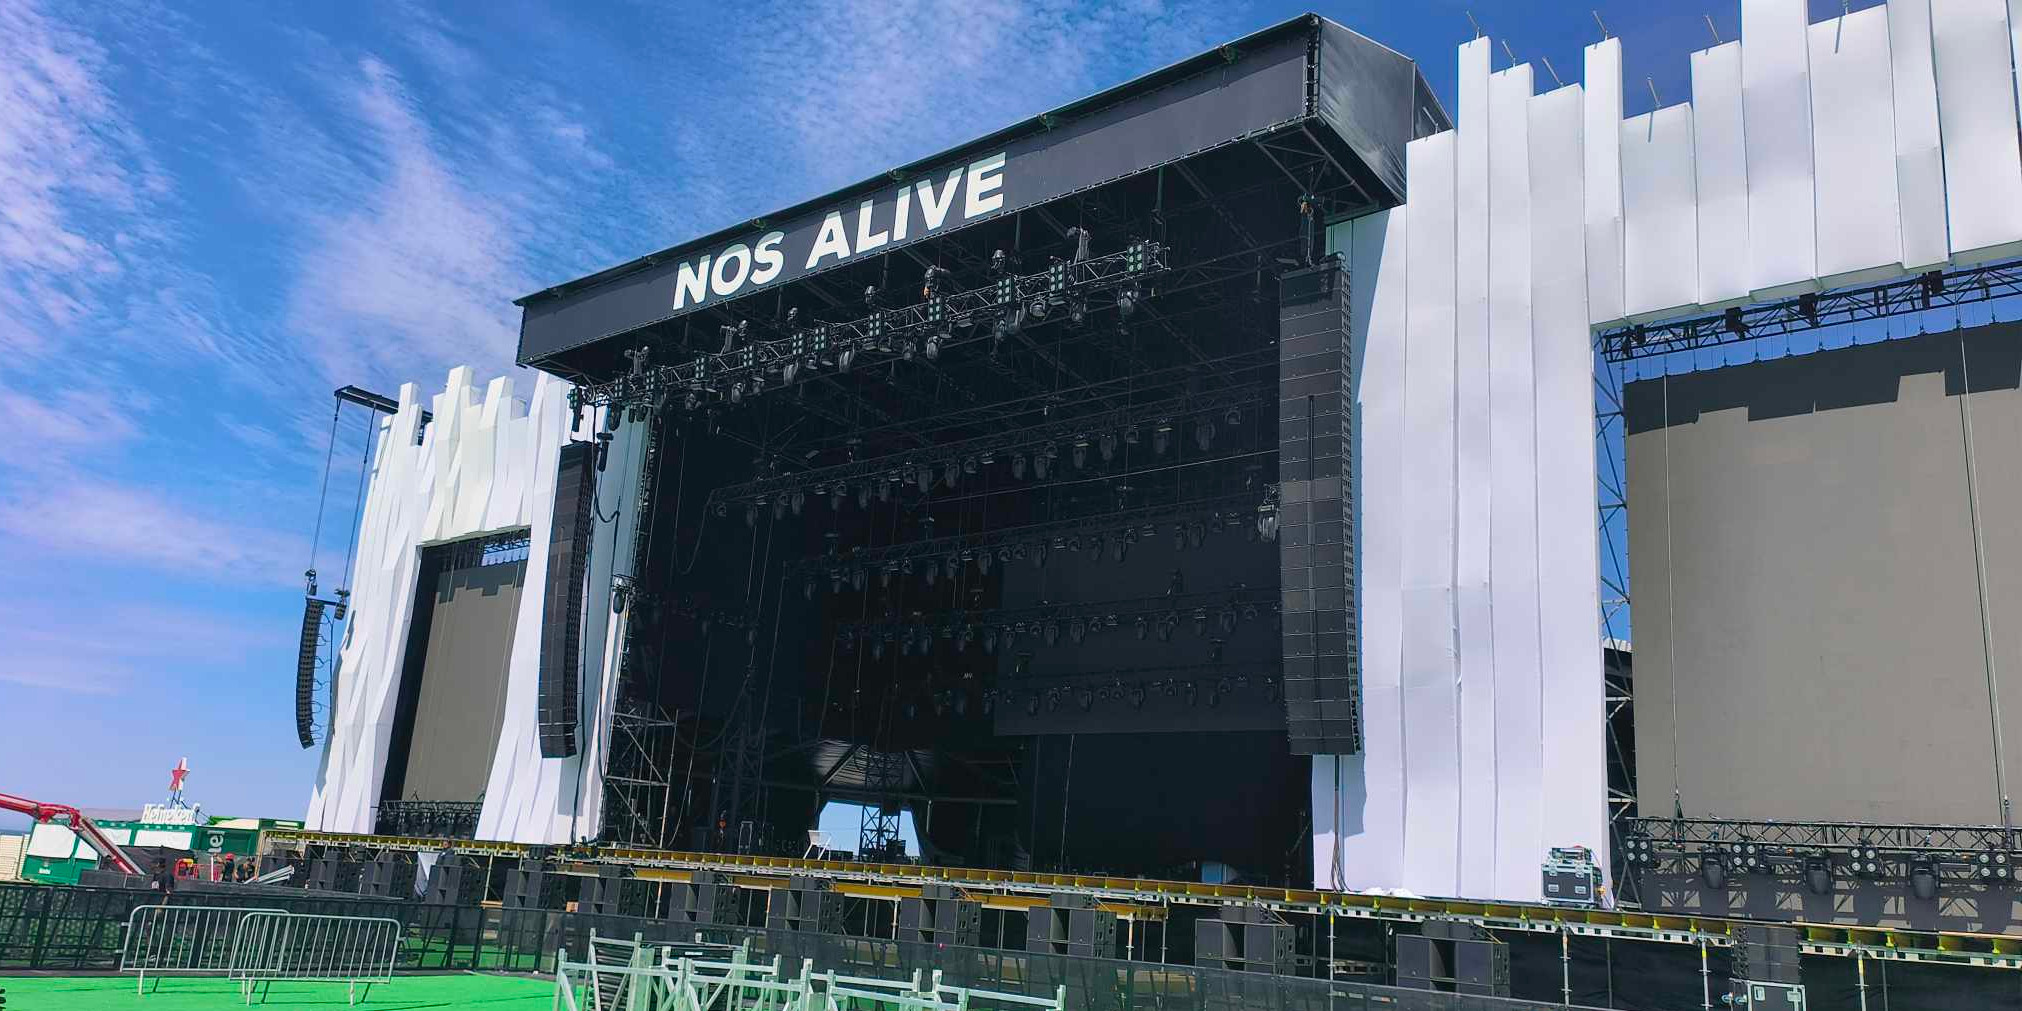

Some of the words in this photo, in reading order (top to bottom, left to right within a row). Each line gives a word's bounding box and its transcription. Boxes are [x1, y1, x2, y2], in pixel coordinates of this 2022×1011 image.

[673, 231, 784, 310] NOS
[805, 152, 1006, 269] ALIVE
[140, 802, 198, 825] Heineken
